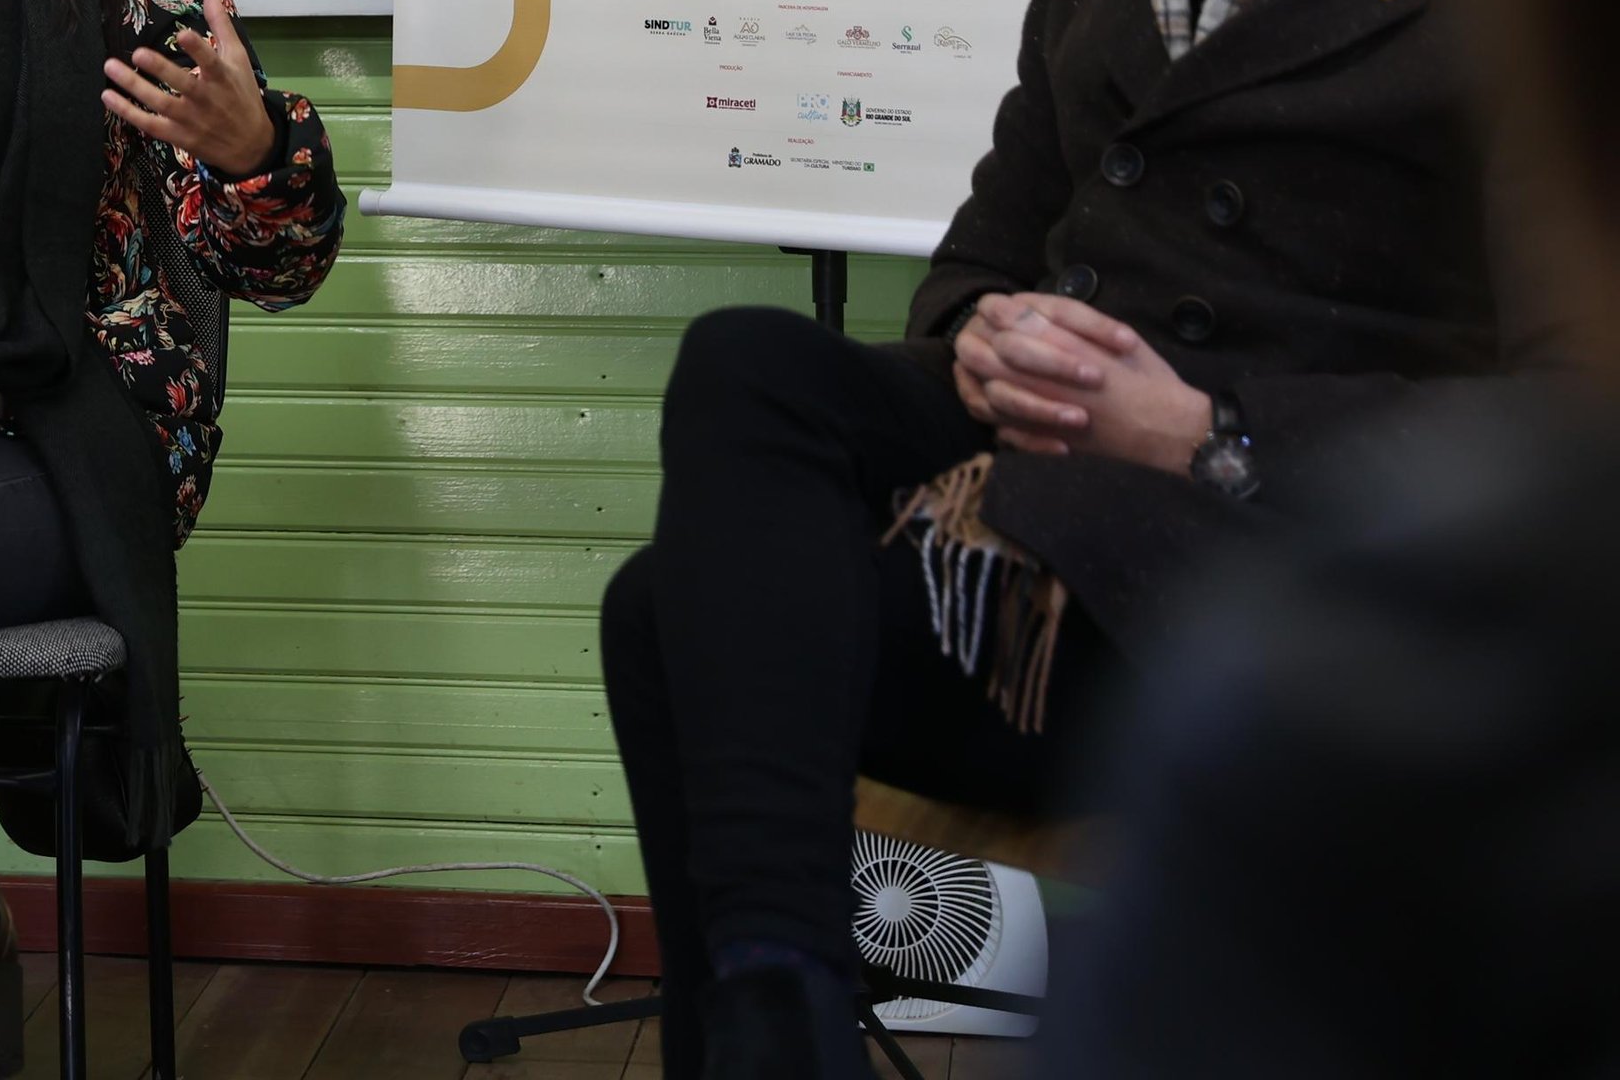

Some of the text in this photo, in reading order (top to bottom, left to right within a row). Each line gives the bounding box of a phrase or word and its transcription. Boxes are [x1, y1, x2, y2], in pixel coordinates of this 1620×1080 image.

[644, 19, 692, 32] SINDTUR
[703, 26, 720, 35] Bella
[703, 33, 722, 42] Viena
[891, 42, 921, 51] Serrazul
[719, 63, 743, 72] PRODUÇÃO
[718, 97, 757, 109] miraceti
[865, 107, 887, 115] GOVERNO
[894, 108, 912, 116] ESTADO
[874, 114, 894, 122] GRANDE
[902, 115, 912, 123] SUL
[743, 156, 782, 167] GRAMADO
